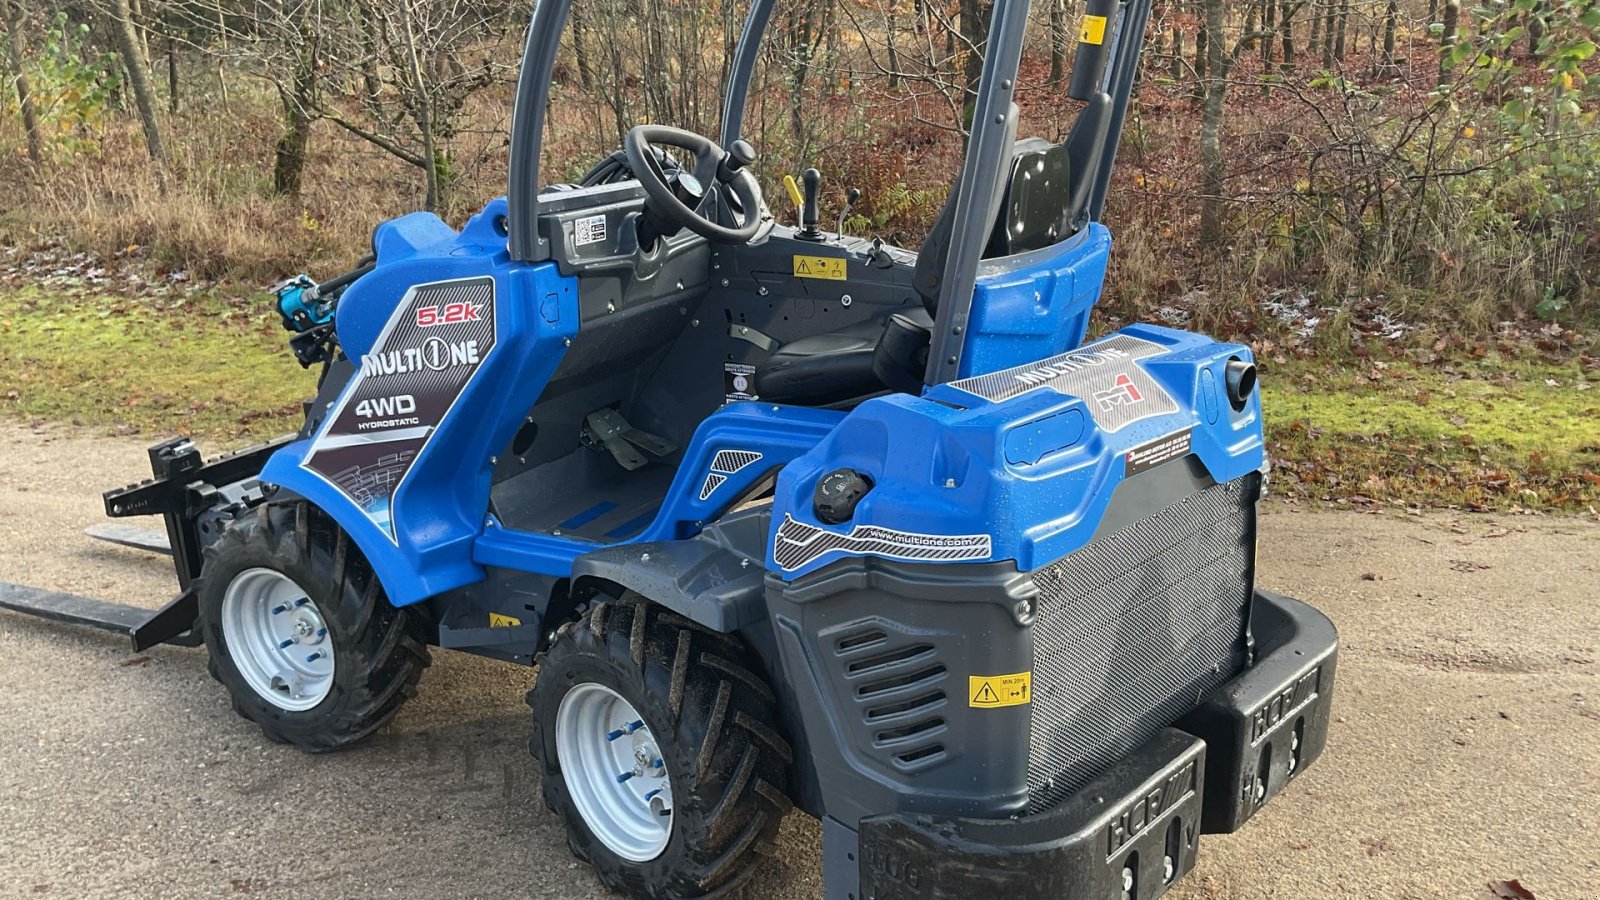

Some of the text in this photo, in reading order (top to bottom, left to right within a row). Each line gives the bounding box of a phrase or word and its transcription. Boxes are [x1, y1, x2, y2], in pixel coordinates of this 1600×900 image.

[417, 303, 482, 327] 5.2k
[355, 394, 416, 418] 4WD
[358, 417, 419, 430] HYDROSTATIC
[869, 529, 972, 547] www.multione.com
